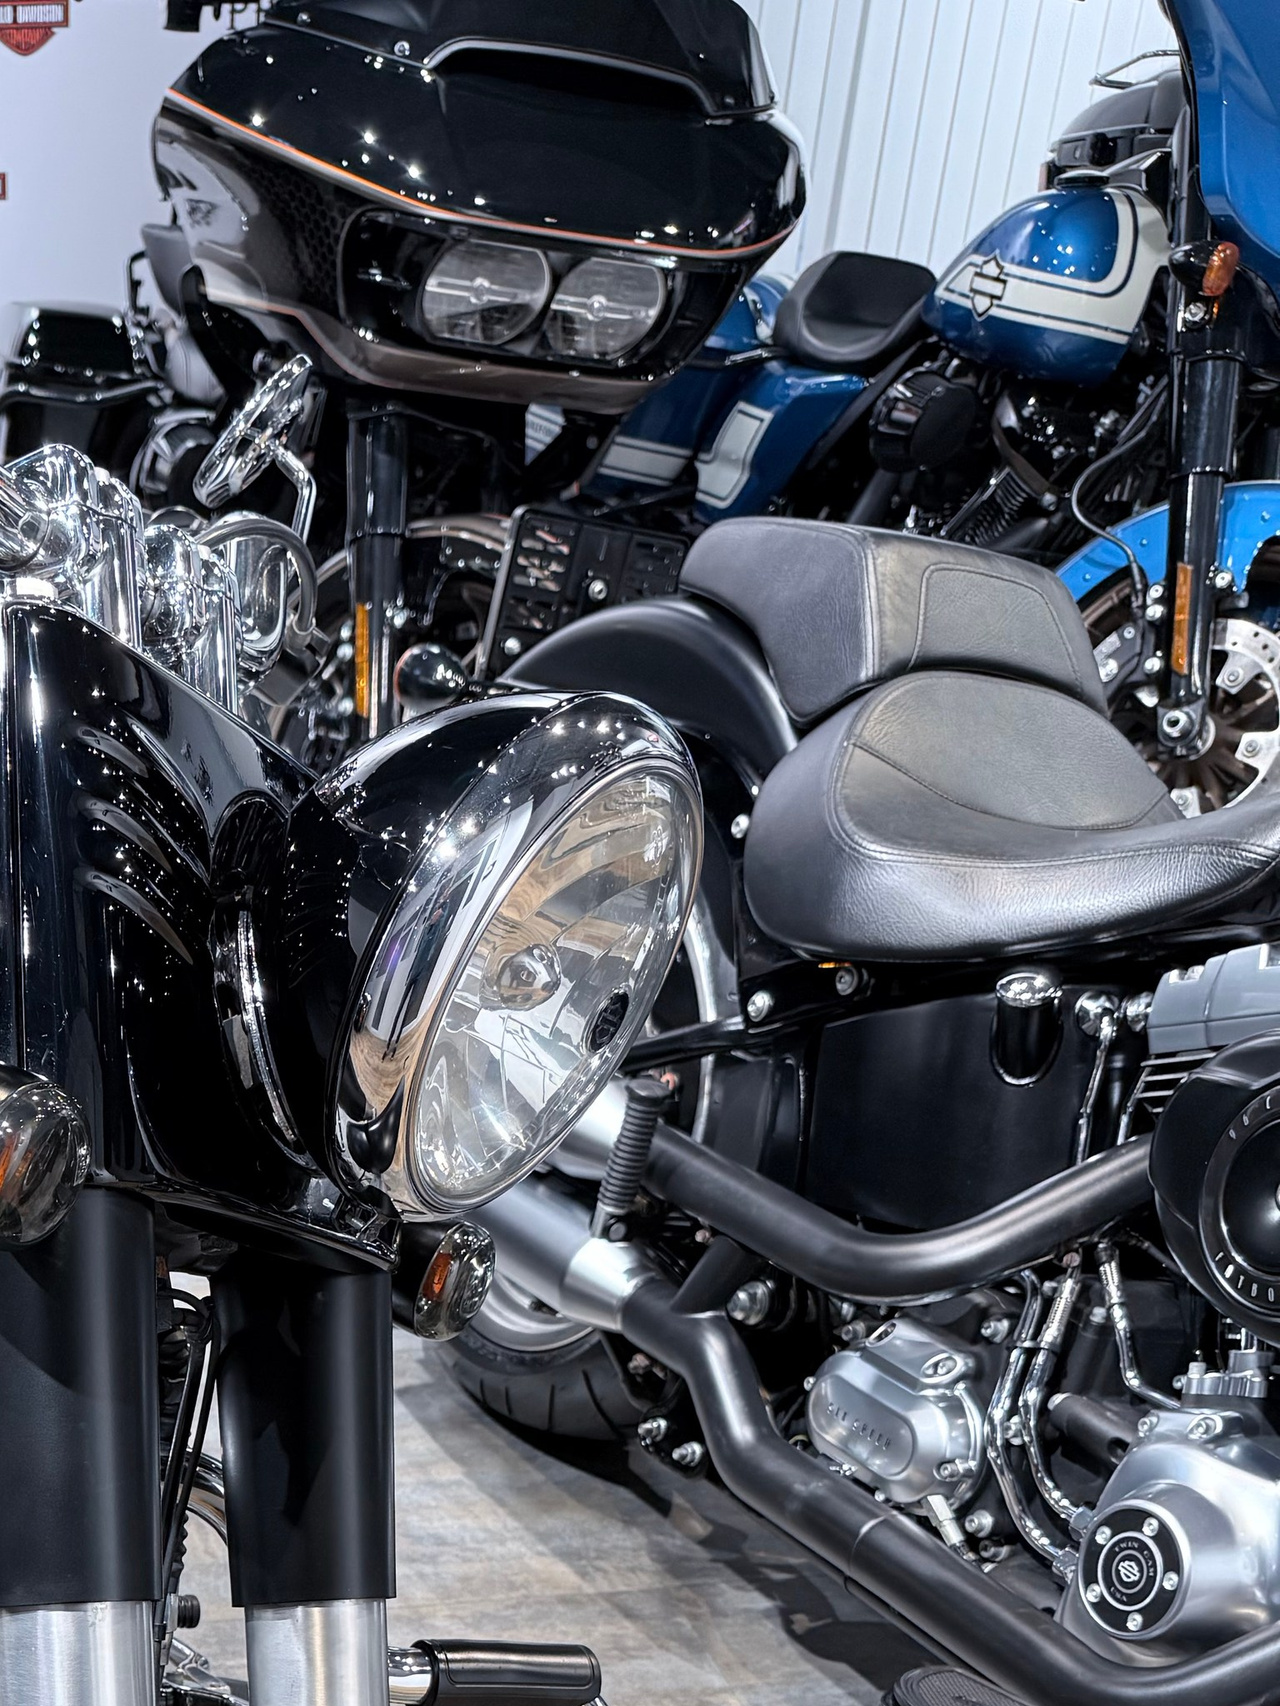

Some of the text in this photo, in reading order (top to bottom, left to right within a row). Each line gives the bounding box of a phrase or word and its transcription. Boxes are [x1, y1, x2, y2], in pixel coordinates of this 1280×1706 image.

[1215, 1251, 1275, 1302] FATBO
[1114, 1541, 1154, 1577] TWIN CAM
